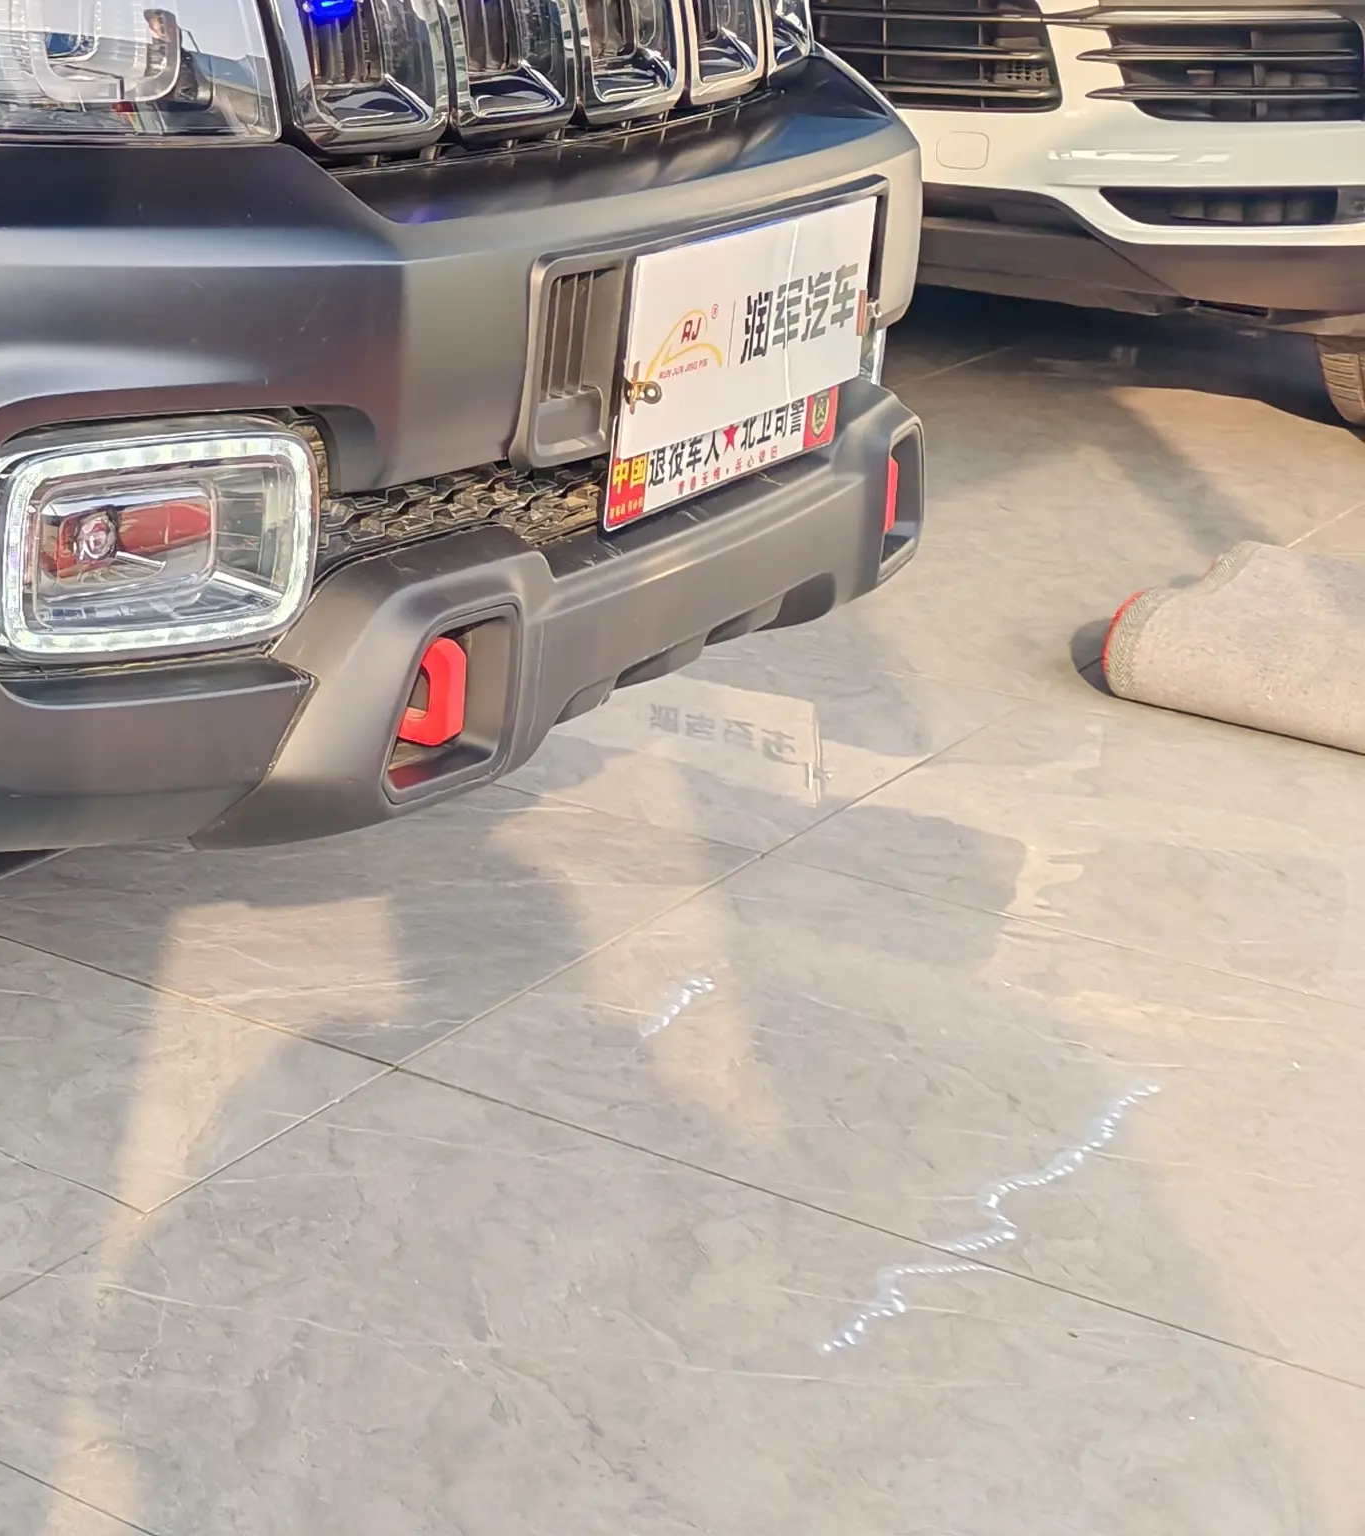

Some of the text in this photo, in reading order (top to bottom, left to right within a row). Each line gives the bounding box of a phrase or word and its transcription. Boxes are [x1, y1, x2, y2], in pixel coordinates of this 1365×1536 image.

[739, 263, 859, 365] 润军汽车
[612, 455, 647, 495] 中国
